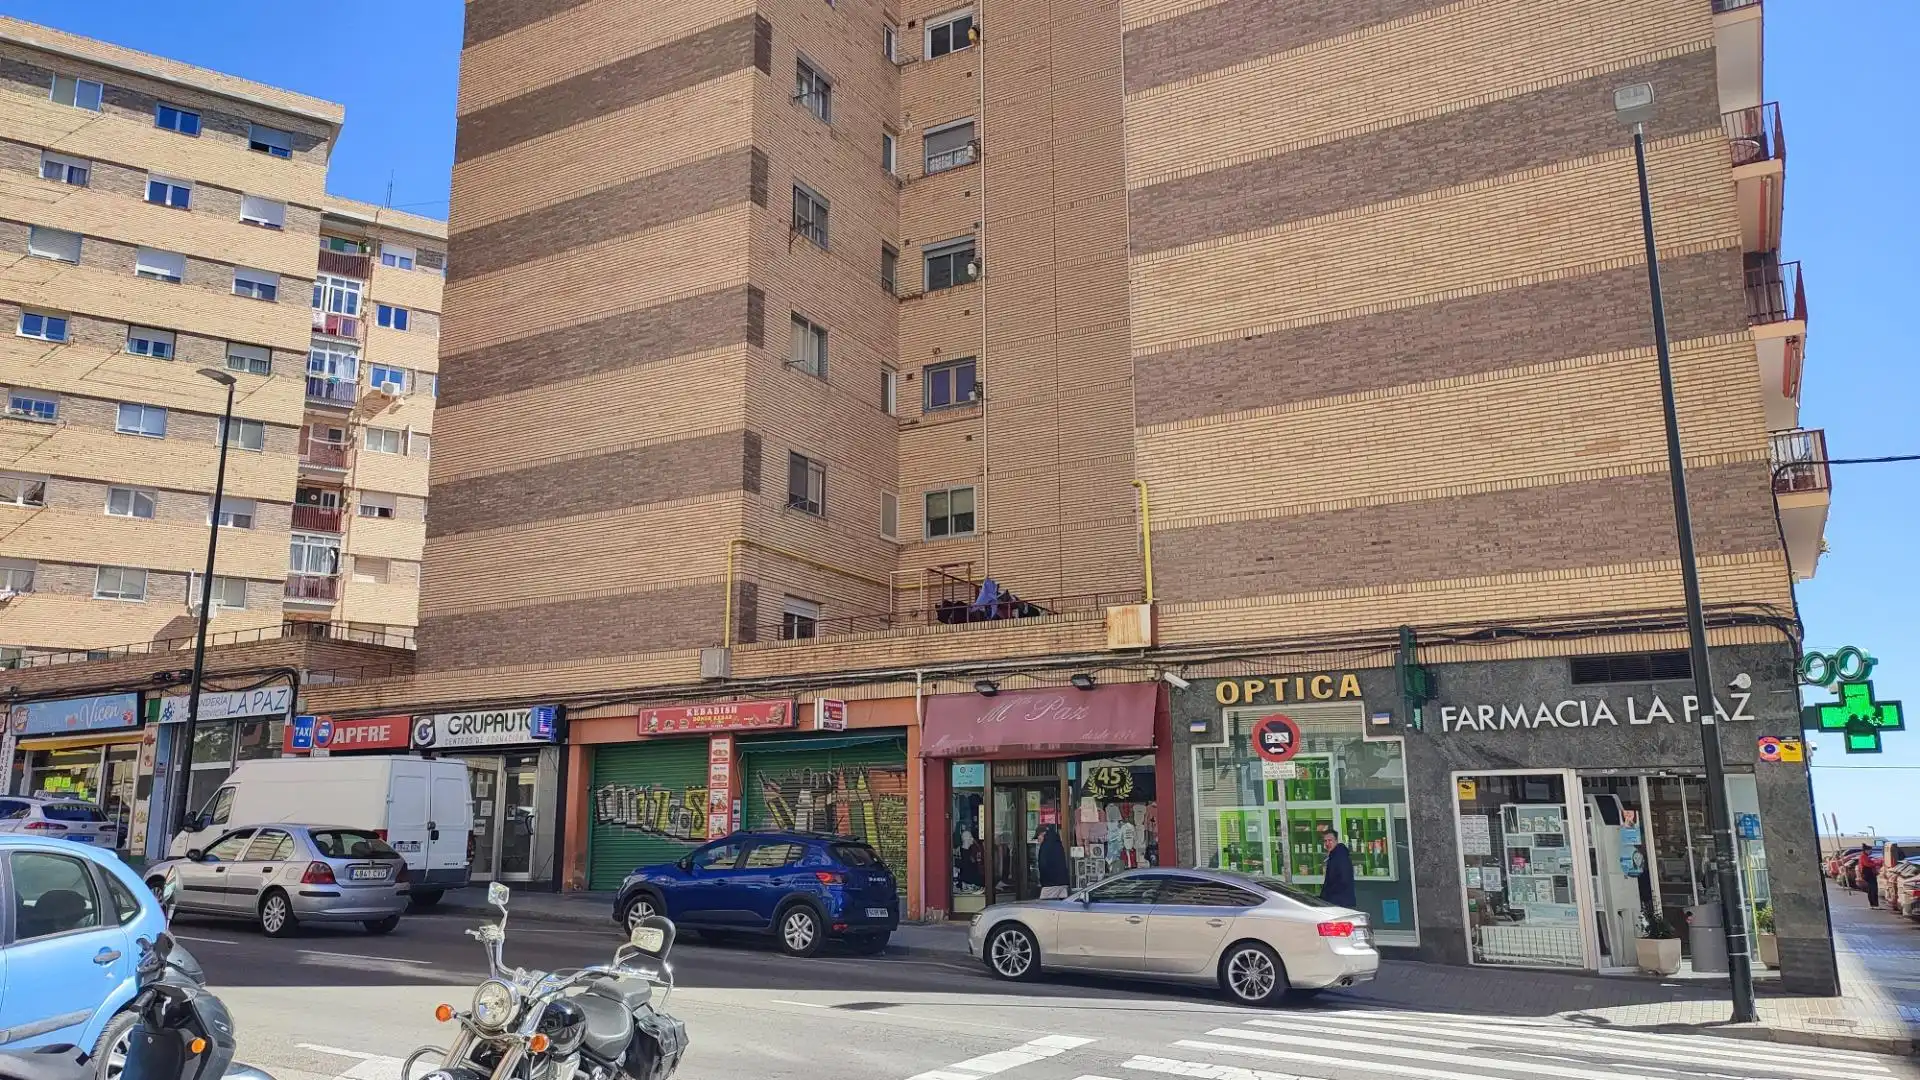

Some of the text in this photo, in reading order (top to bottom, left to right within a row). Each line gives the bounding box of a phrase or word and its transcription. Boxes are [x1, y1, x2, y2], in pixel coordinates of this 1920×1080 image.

[1215, 673, 1362, 705] OPTICA
[227, 693, 248, 715] LA
[252, 689, 288, 713] PAZ
[1440, 699, 1618, 732] FARMACIA
[1627, 696, 1675, 725] LA
[295, 727, 313, 737] TAXI
[332, 725, 391, 744] APFRE
[1097, 767, 1121, 785] 45
